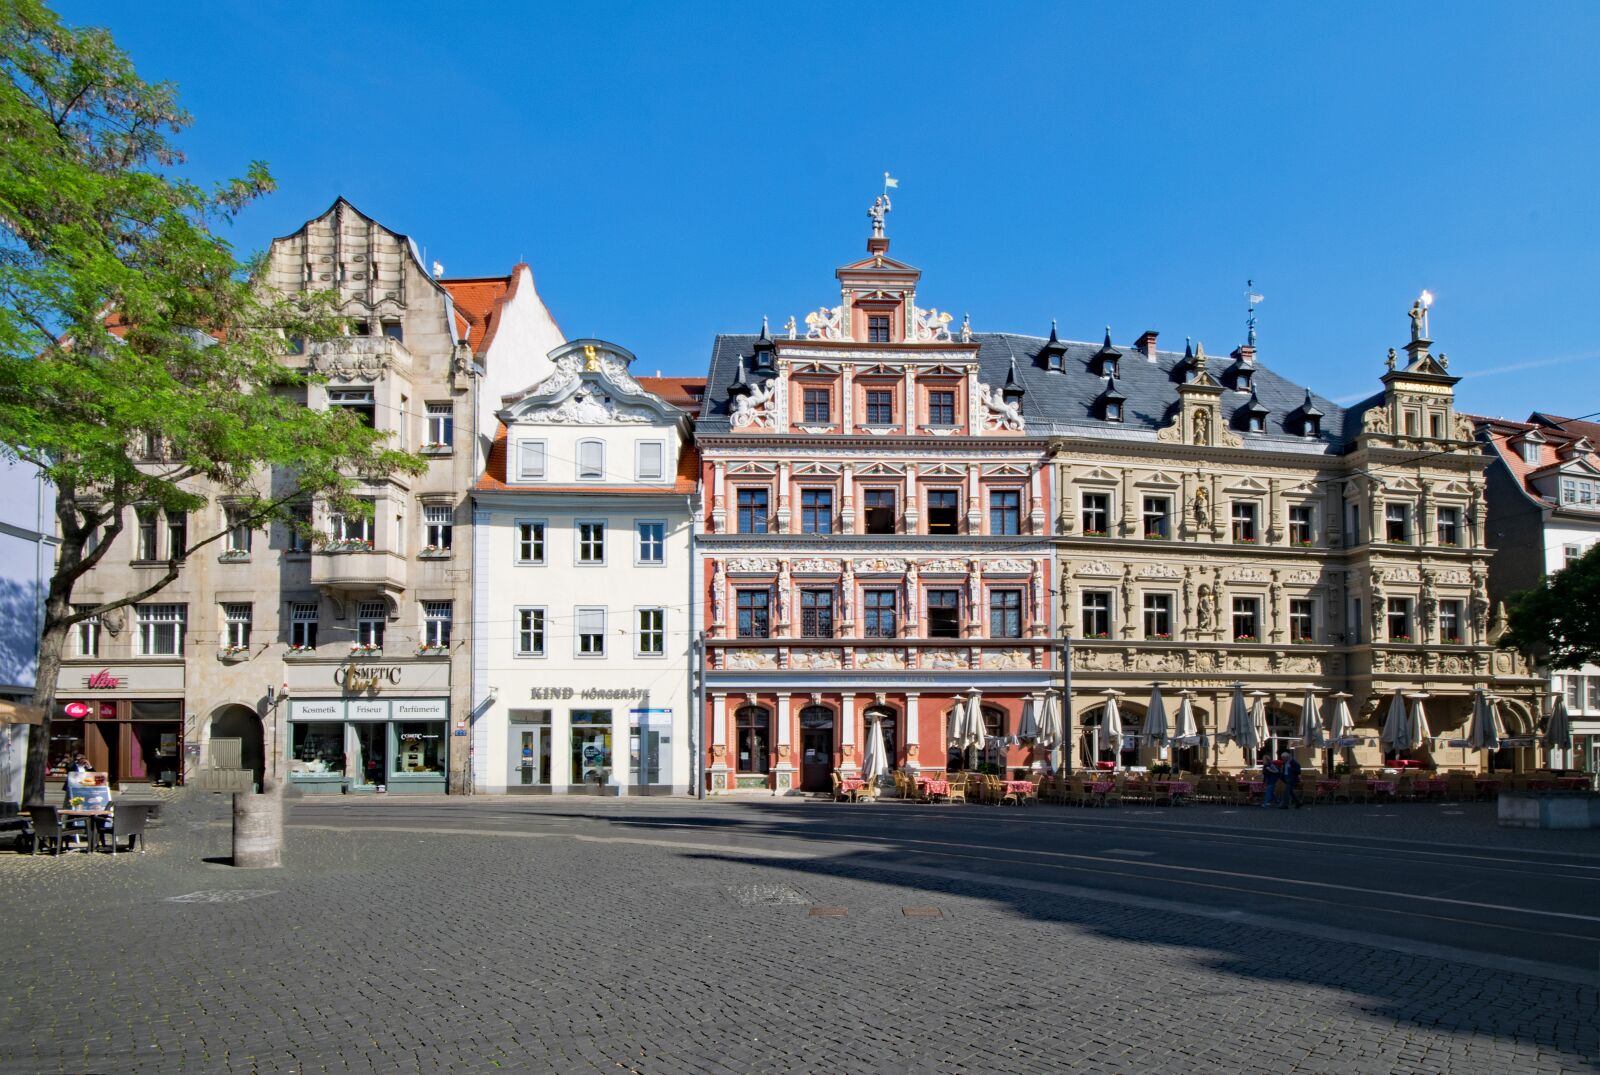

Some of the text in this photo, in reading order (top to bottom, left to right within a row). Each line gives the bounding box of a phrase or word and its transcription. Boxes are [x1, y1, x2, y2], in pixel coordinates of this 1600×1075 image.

[530, 687, 574, 700] KIND
[302, 705, 336, 714] Kosmetik
[356, 705, 382, 713] Friseur
[399, 705, 440, 713] Parfümerie
